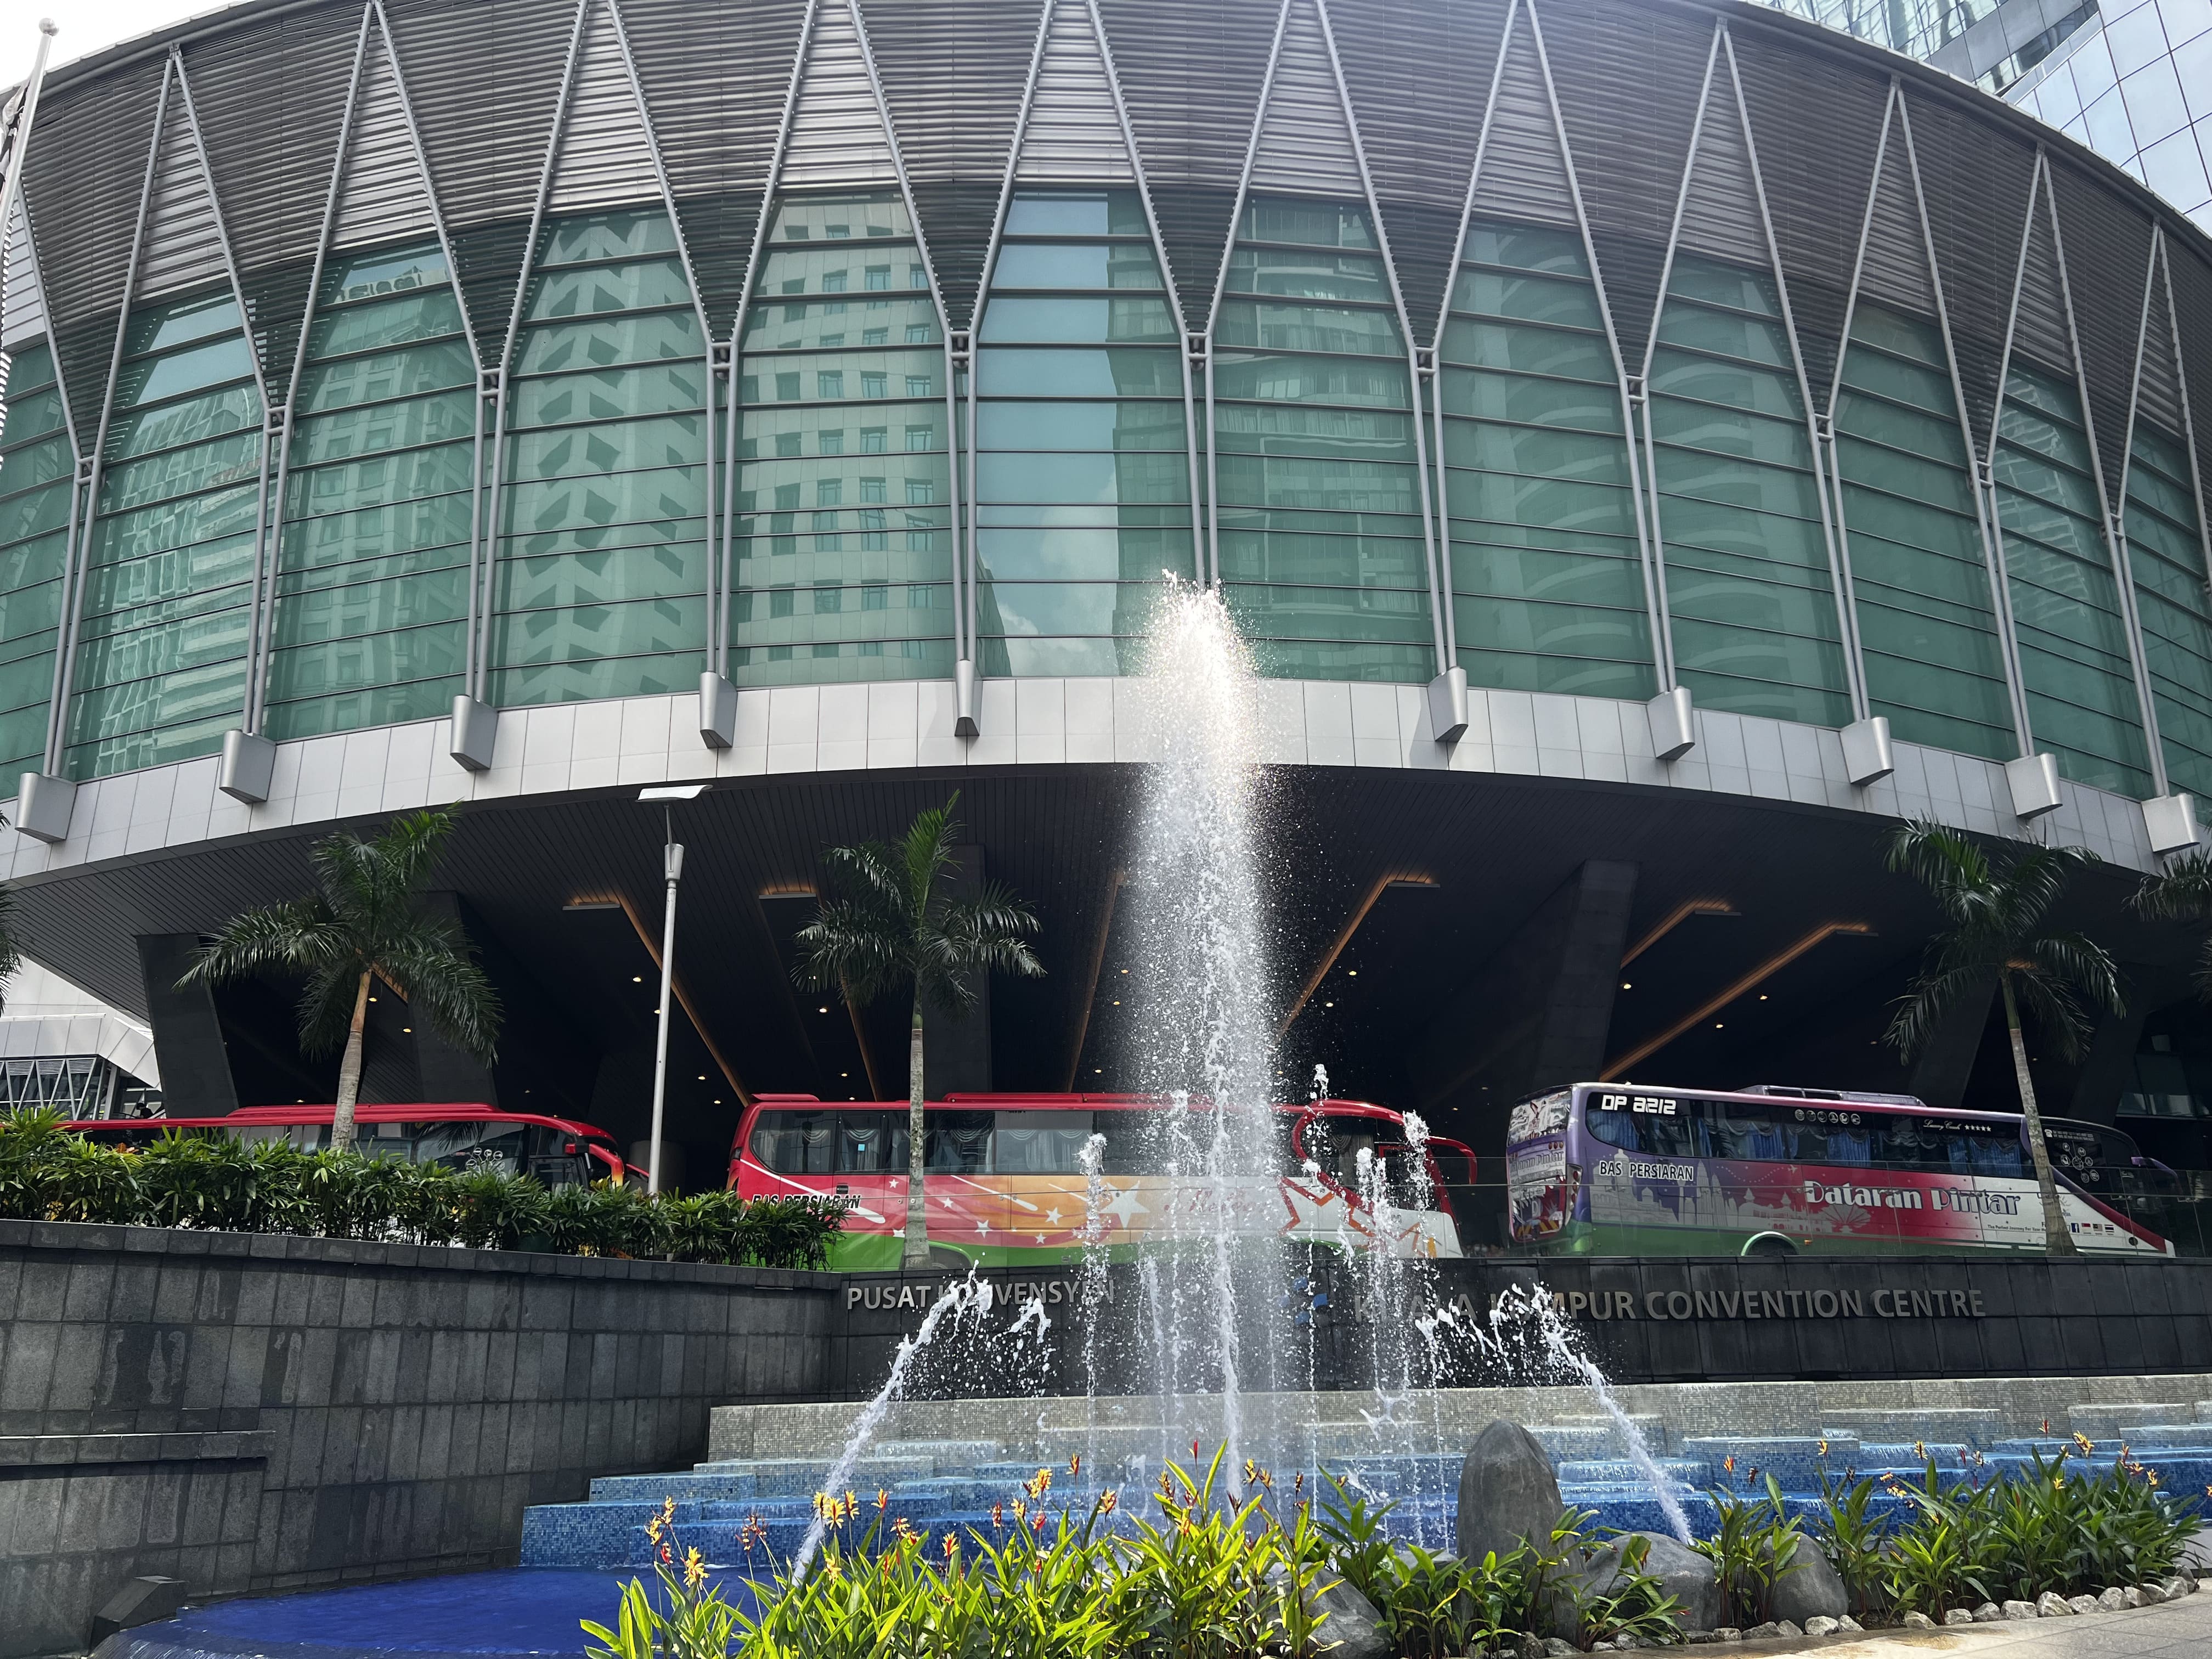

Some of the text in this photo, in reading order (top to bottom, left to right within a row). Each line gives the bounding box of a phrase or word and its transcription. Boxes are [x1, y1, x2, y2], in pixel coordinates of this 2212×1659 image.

[1599, 1160, 1694, 1181] BAS PERSIARAN
[1803, 1180, 2021, 1216] Dataran Pintar
[848, 1279, 1114, 1310] PUSAT KOVENSYEN
[1646, 1289, 1865, 1319] CONVENTION
[1872, 1289, 1986, 1318] CENTRE
